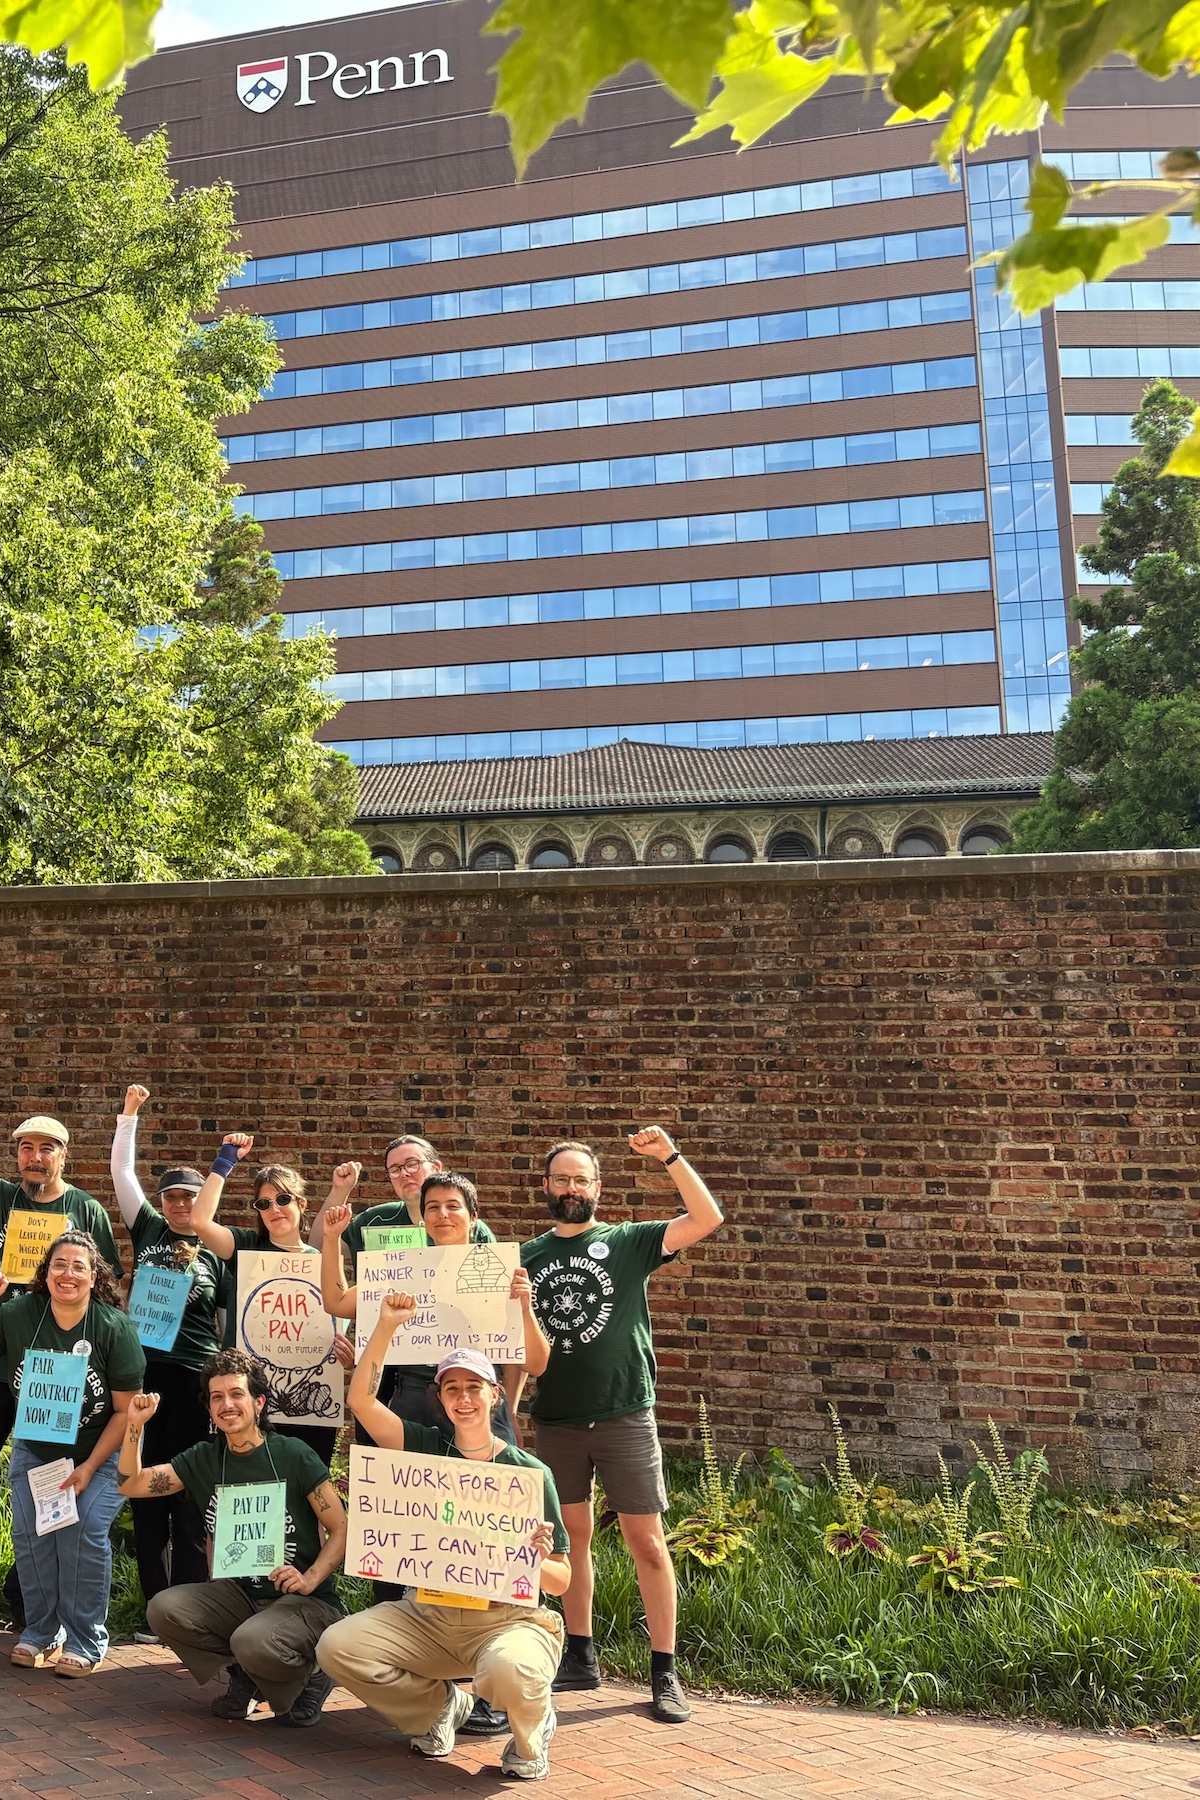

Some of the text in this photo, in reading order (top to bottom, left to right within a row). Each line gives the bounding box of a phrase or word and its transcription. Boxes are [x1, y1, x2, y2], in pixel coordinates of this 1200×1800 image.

[294, 48, 455, 106] Penn
[28, 1217, 48, 1227] DON'T
[19, 1230, 38, 1240] LEAVE
[39, 1231, 52, 1241] OUR
[378, 1233, 412, 1245] THE ART IS
[19, 1244, 40, 1254] WAGES
[383, 1251, 406, 1262] THE
[261, 1258, 312, 1273] I SEE
[150, 1274, 176, 1290] LIVABLE
[364, 1266, 436, 1283] ANSWER TO
[548, 1273, 586, 1289] AFSCME
[569, 1256, 614, 1296] WORKERS
[147, 1290, 170, 1305] WAGES:
[261, 1291, 309, 1317] FAIR
[361, 1290, 381, 1301] THE
[135, 1305, 146, 1317] CAN
[148, 1307, 160, 1319] YOU
[143, 1323, 156, 1335] IT?
[547, 1311, 588, 1331] LOCAL 397
[579, 1302, 614, 1344] UNITED
[269, 1319, 305, 1342] PAY
[261, 1344, 324, 1355] IN OUR FUTURE
[358, 1336, 368, 1348] IS
[411, 1335, 431, 1345] OUR
[437, 1334, 459, 1350] PAY
[468, 1334, 480, 1343] IS
[485, 1333, 508, 1343] TOO
[484, 1347, 526, 1360] ITTLE
[32, 1357, 55, 1375] FAIR
[28, 1382, 81, 1403] CONTRACT
[24, 1406, 52, 1425] NOW!
[358, 1455, 376, 1484] I
[391, 1463, 450, 1490] WORK
[459, 1473, 499, 1491] FOR
[508, 1476, 525, 1495] A
[232, 1495, 270, 1515] PAY UP
[359, 1495, 540, 1534] BILLION MUSEUM
[233, 1521, 267, 1541] PENN!
[364, 1529, 401, 1547] BUT
[409, 1534, 427, 1551] I
[438, 1537, 497, 1559] CAN'T
[505, 1546, 539, 1568] PAY
[396, 1557, 505, 1589] MY RENT
